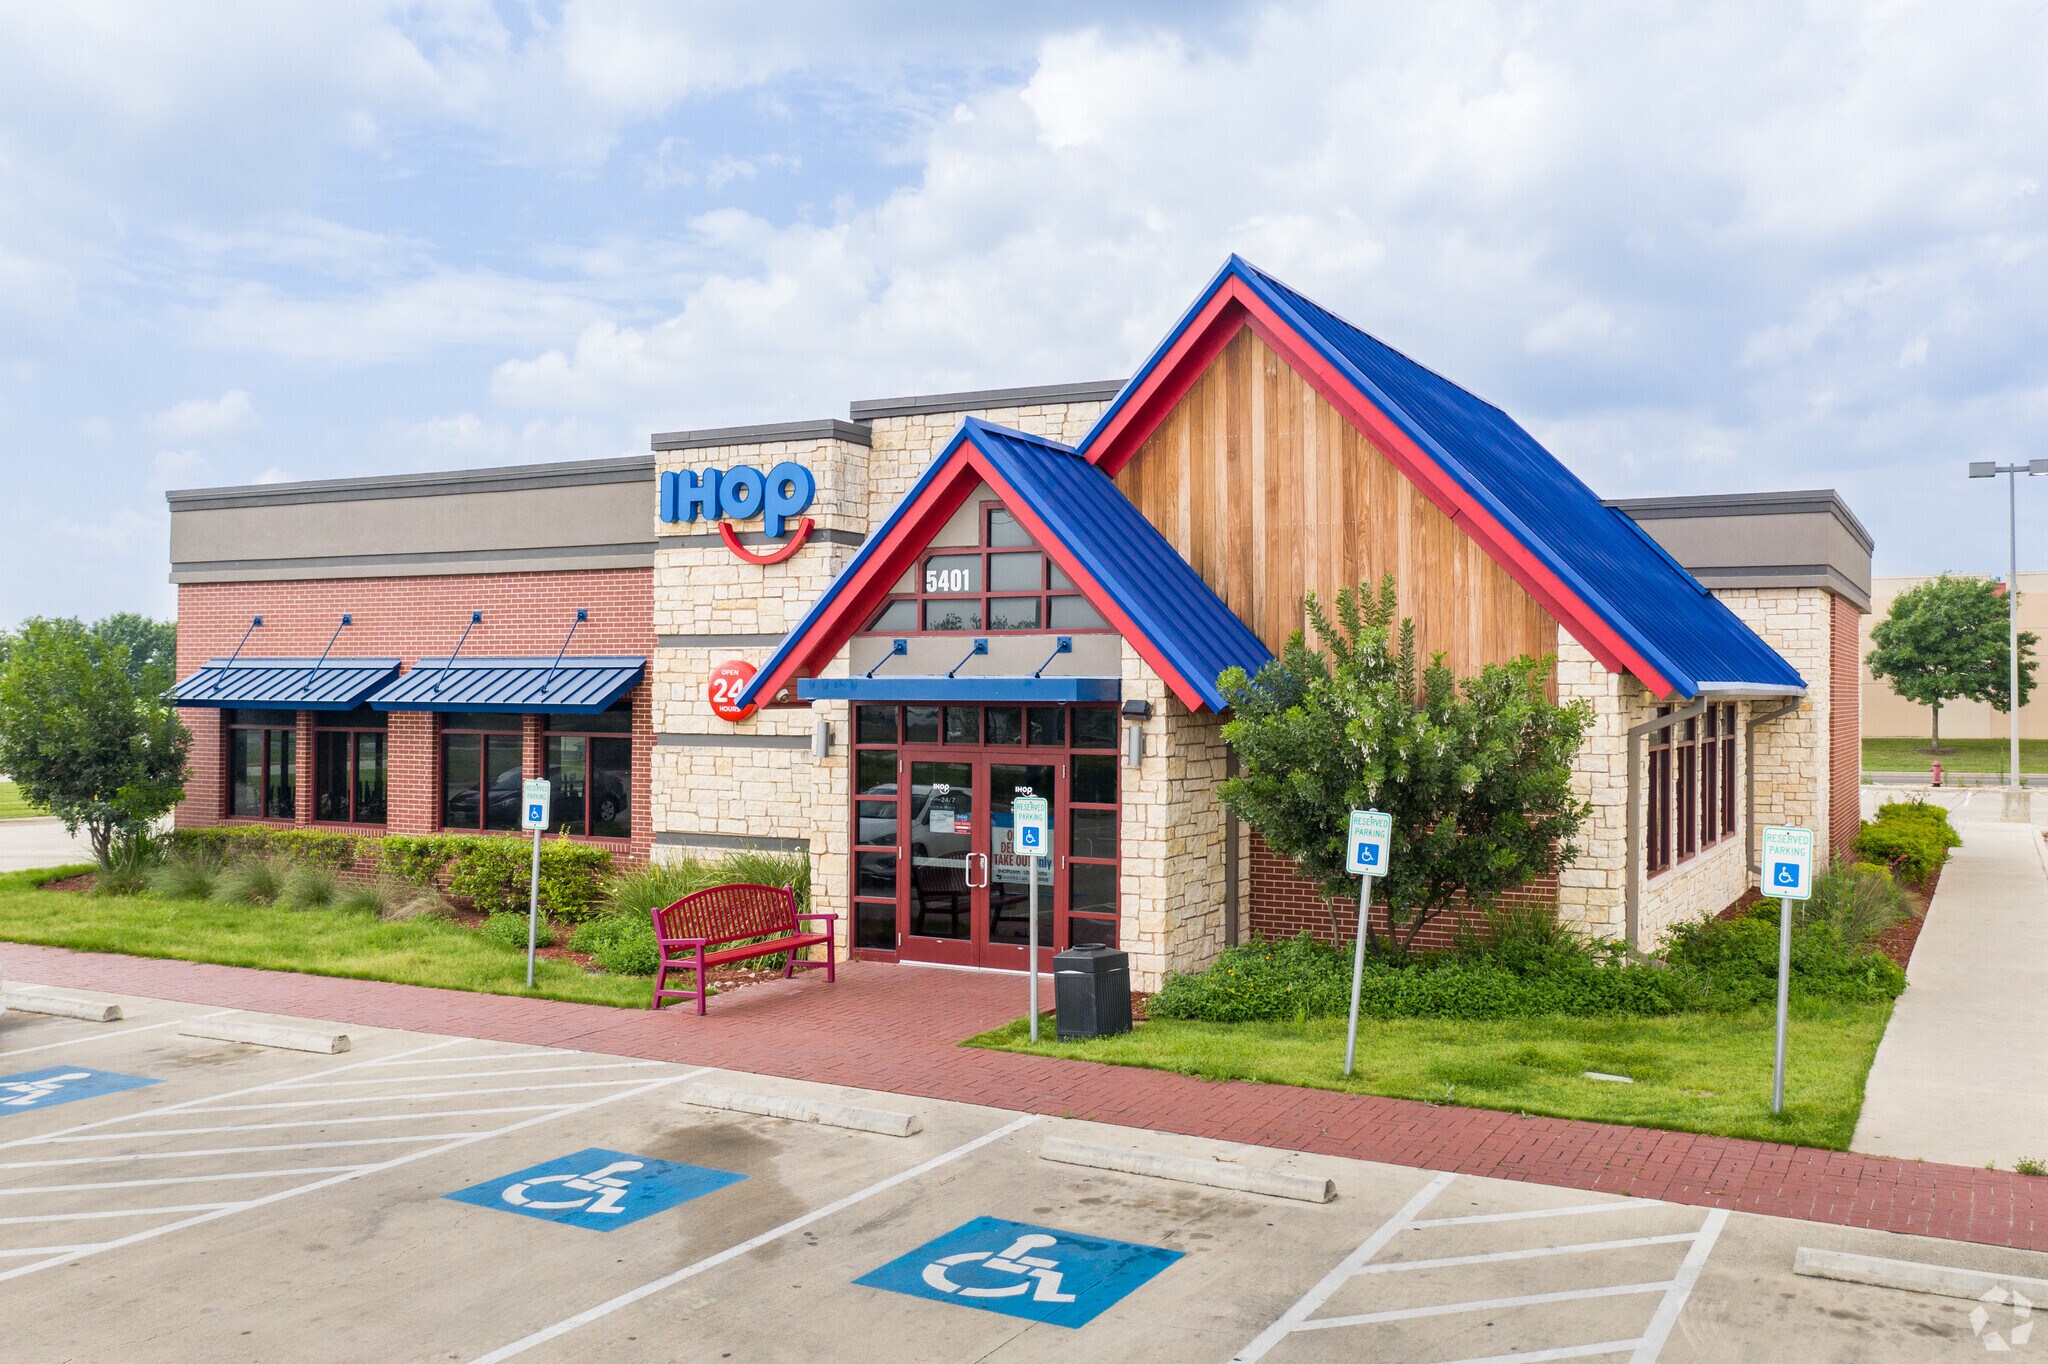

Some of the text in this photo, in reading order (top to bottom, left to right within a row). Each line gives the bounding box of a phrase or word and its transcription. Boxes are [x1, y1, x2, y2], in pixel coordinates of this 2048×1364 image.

[926, 569, 970, 592] 5401
[713, 678, 744, 703] 24
[1016, 803, 1045, 812] RESERVED
[1019, 813, 1043, 821] PARKING
[1353, 817, 1388, 828] RESERVED
[1355, 827, 1385, 839] PARKING
[1767, 834, 1809, 845] RESERVED
[1769, 846, 1806, 857] PARKING
[994, 854, 1014, 866] TAKE
[1037, 857, 1052, 870] nly
